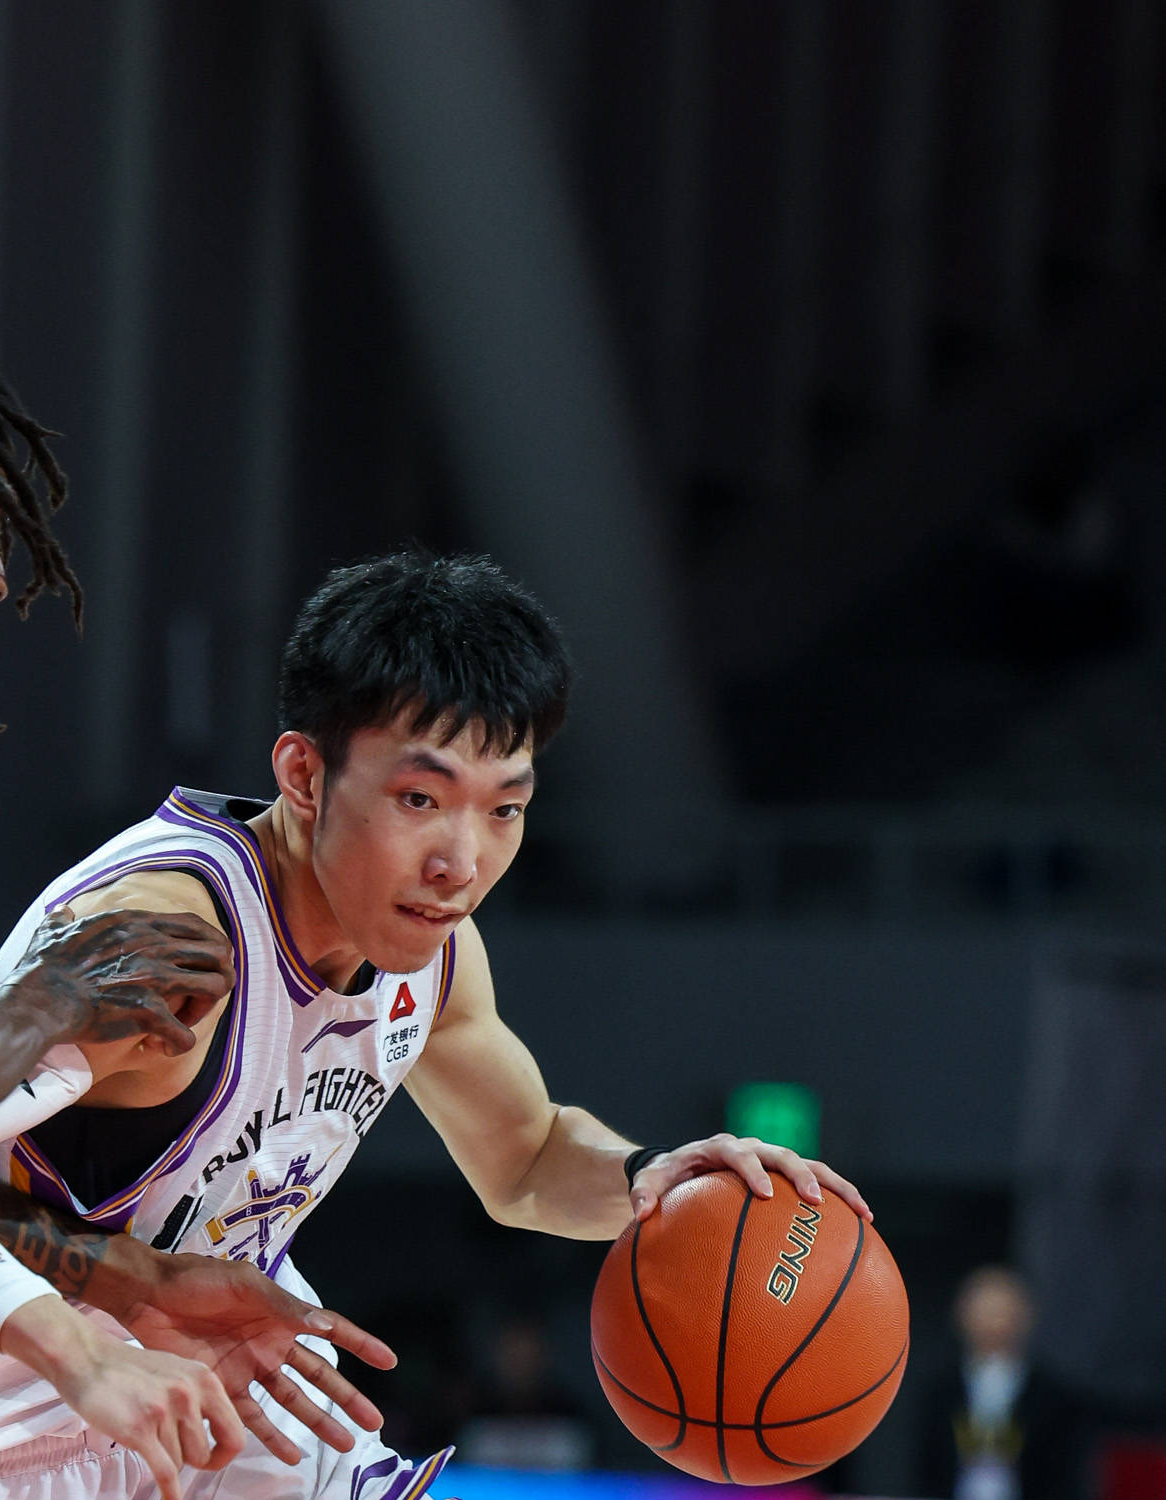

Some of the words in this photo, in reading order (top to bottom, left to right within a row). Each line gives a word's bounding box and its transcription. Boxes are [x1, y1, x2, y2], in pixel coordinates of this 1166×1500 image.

[386, 1043, 409, 1063] CGB
[201, 1087, 292, 1185] ROYL
[766, 1198, 826, 1306] NING
